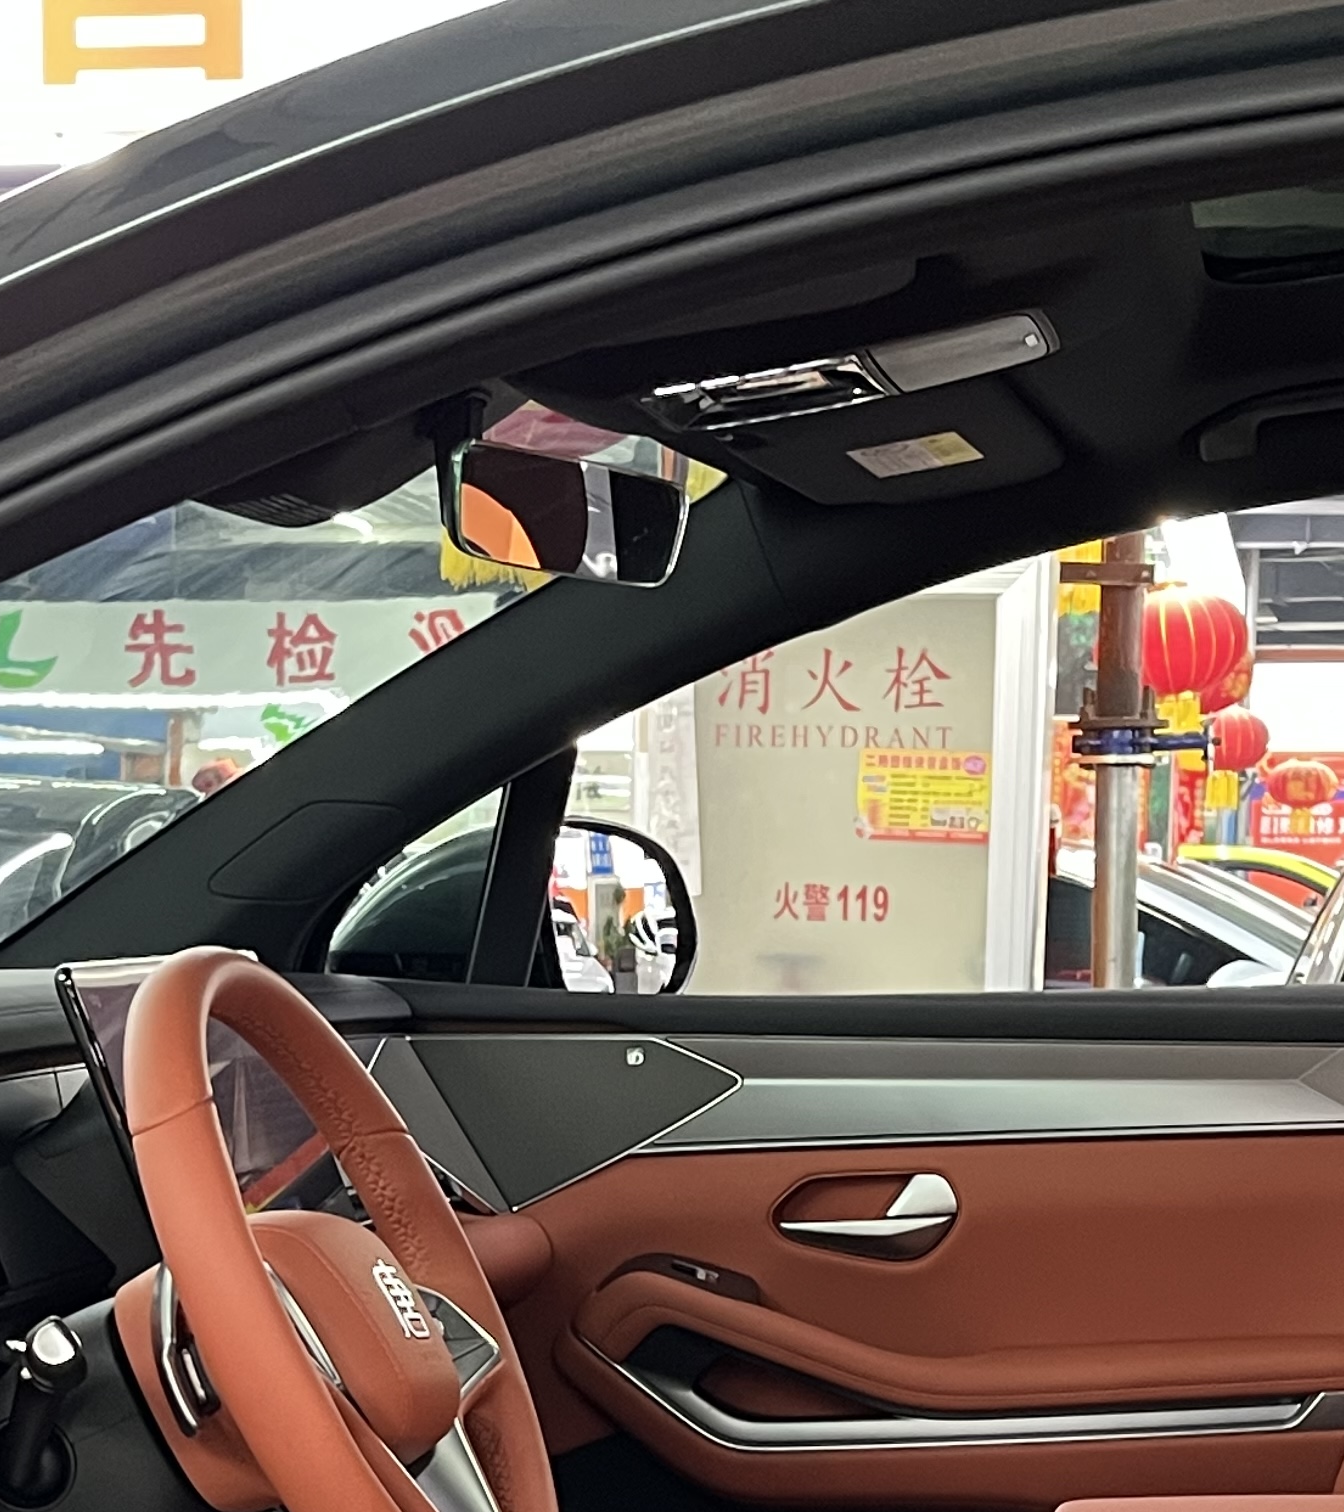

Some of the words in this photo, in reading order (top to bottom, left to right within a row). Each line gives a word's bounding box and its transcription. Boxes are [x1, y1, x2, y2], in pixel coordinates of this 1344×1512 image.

[717, 646, 951, 714] 消火栓
[714, 723, 953, 750] FIREHYDRANT
[773, 881, 890, 923] 火警119
